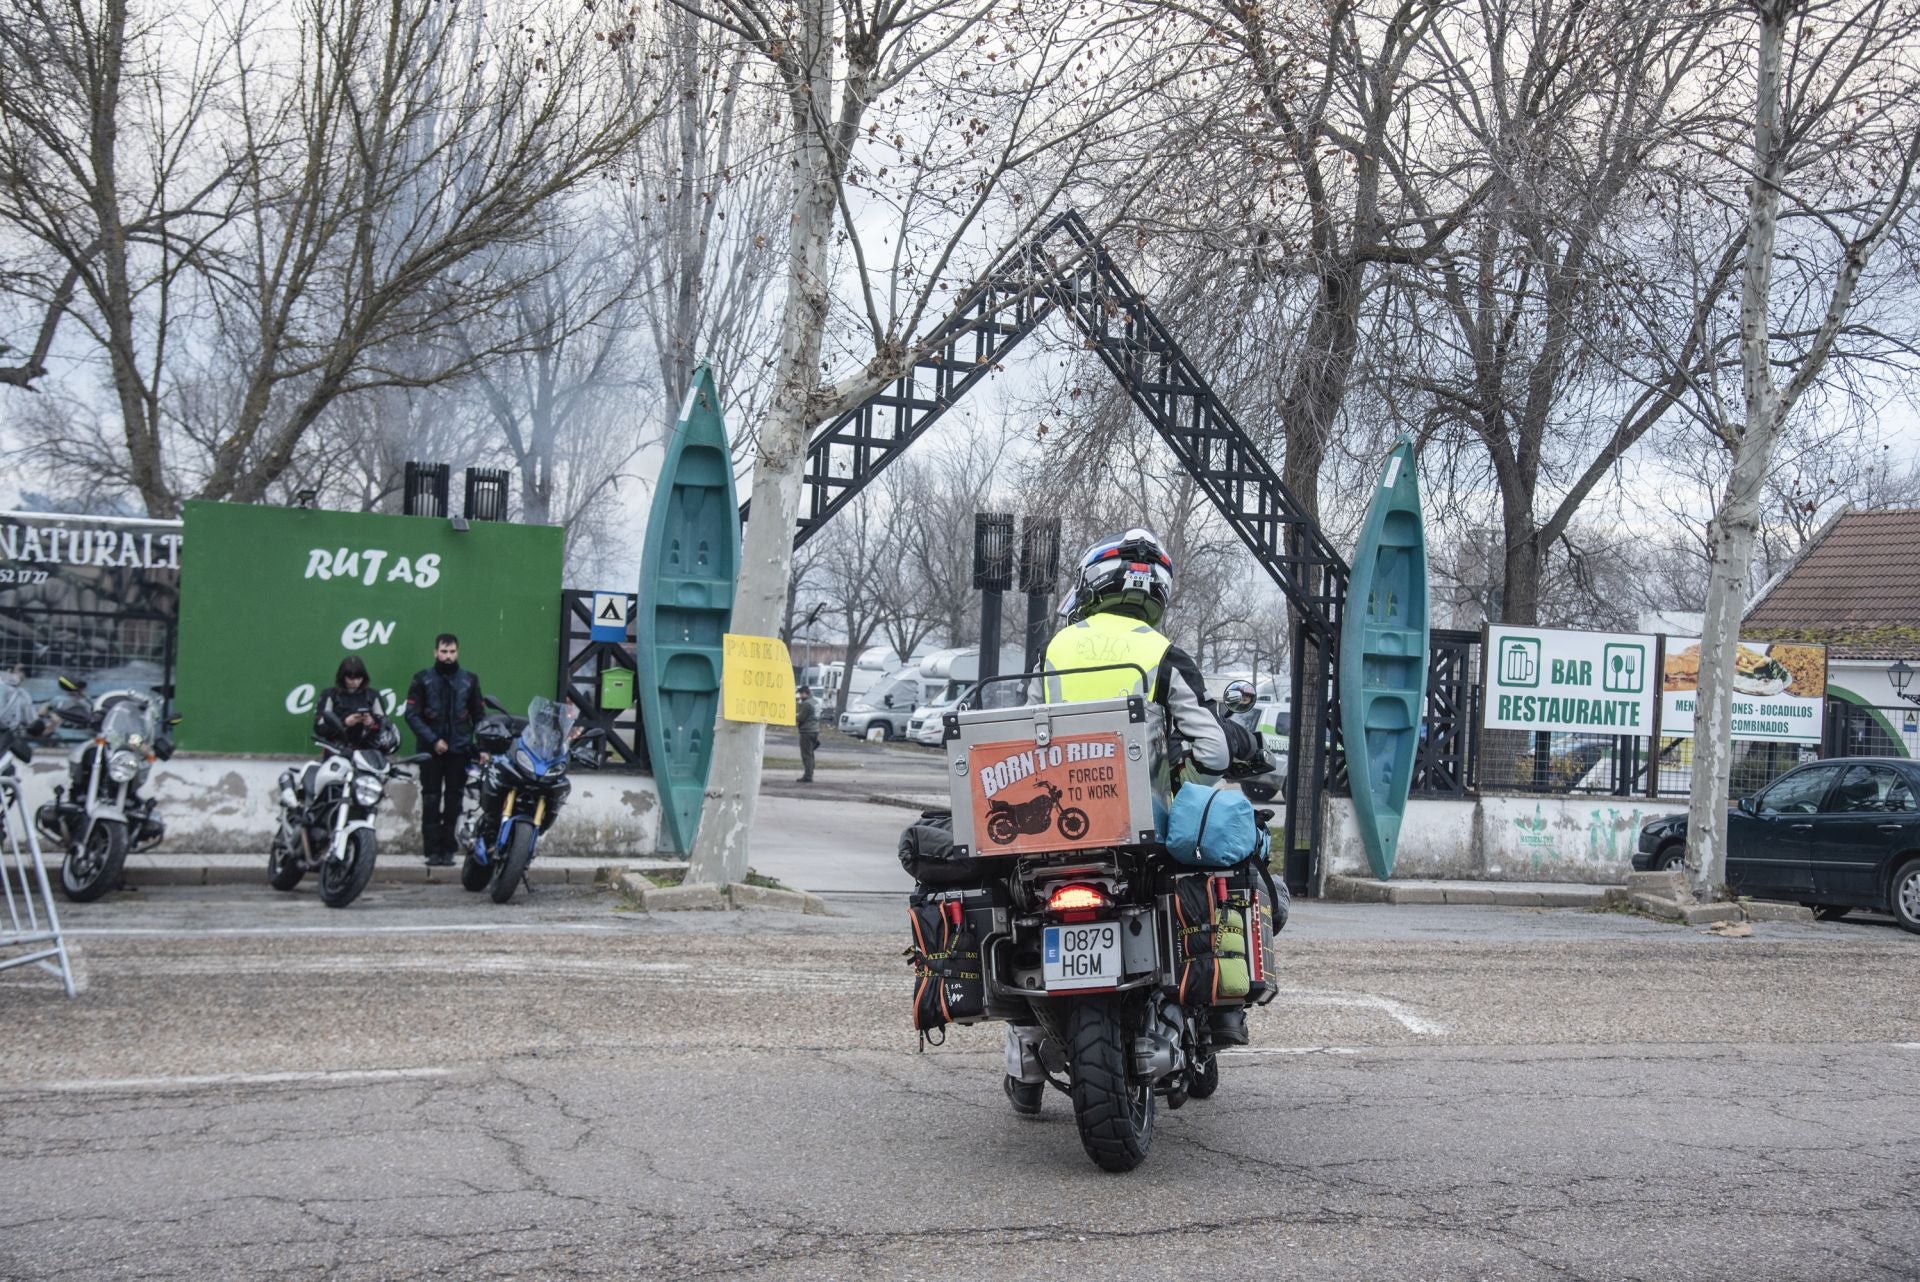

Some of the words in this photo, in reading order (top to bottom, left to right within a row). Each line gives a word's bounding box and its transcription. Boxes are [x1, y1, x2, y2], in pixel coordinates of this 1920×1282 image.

[304, 547, 441, 588] RUTAS
[743, 669, 784, 689] SOLO
[1551, 658, 1592, 686] BAR
[1498, 694, 1640, 726] RESTAURANTE
[1760, 704, 1813, 718] BOCADILLOS
[1731, 719, 1789, 733] COMBINADOS
[980, 751, 1035, 799] BORN
[1035, 745, 1062, 781] TO
[1066, 742, 1116, 763] RIDE
[1069, 766, 1114, 783] FORCED
[1068, 787, 1082, 801] TO
[1088, 783, 1118, 801] WORK
[1064, 927, 1114, 952] 0879
[1049, 949, 1056, 958] E
[1062, 953, 1102, 977] HGM
